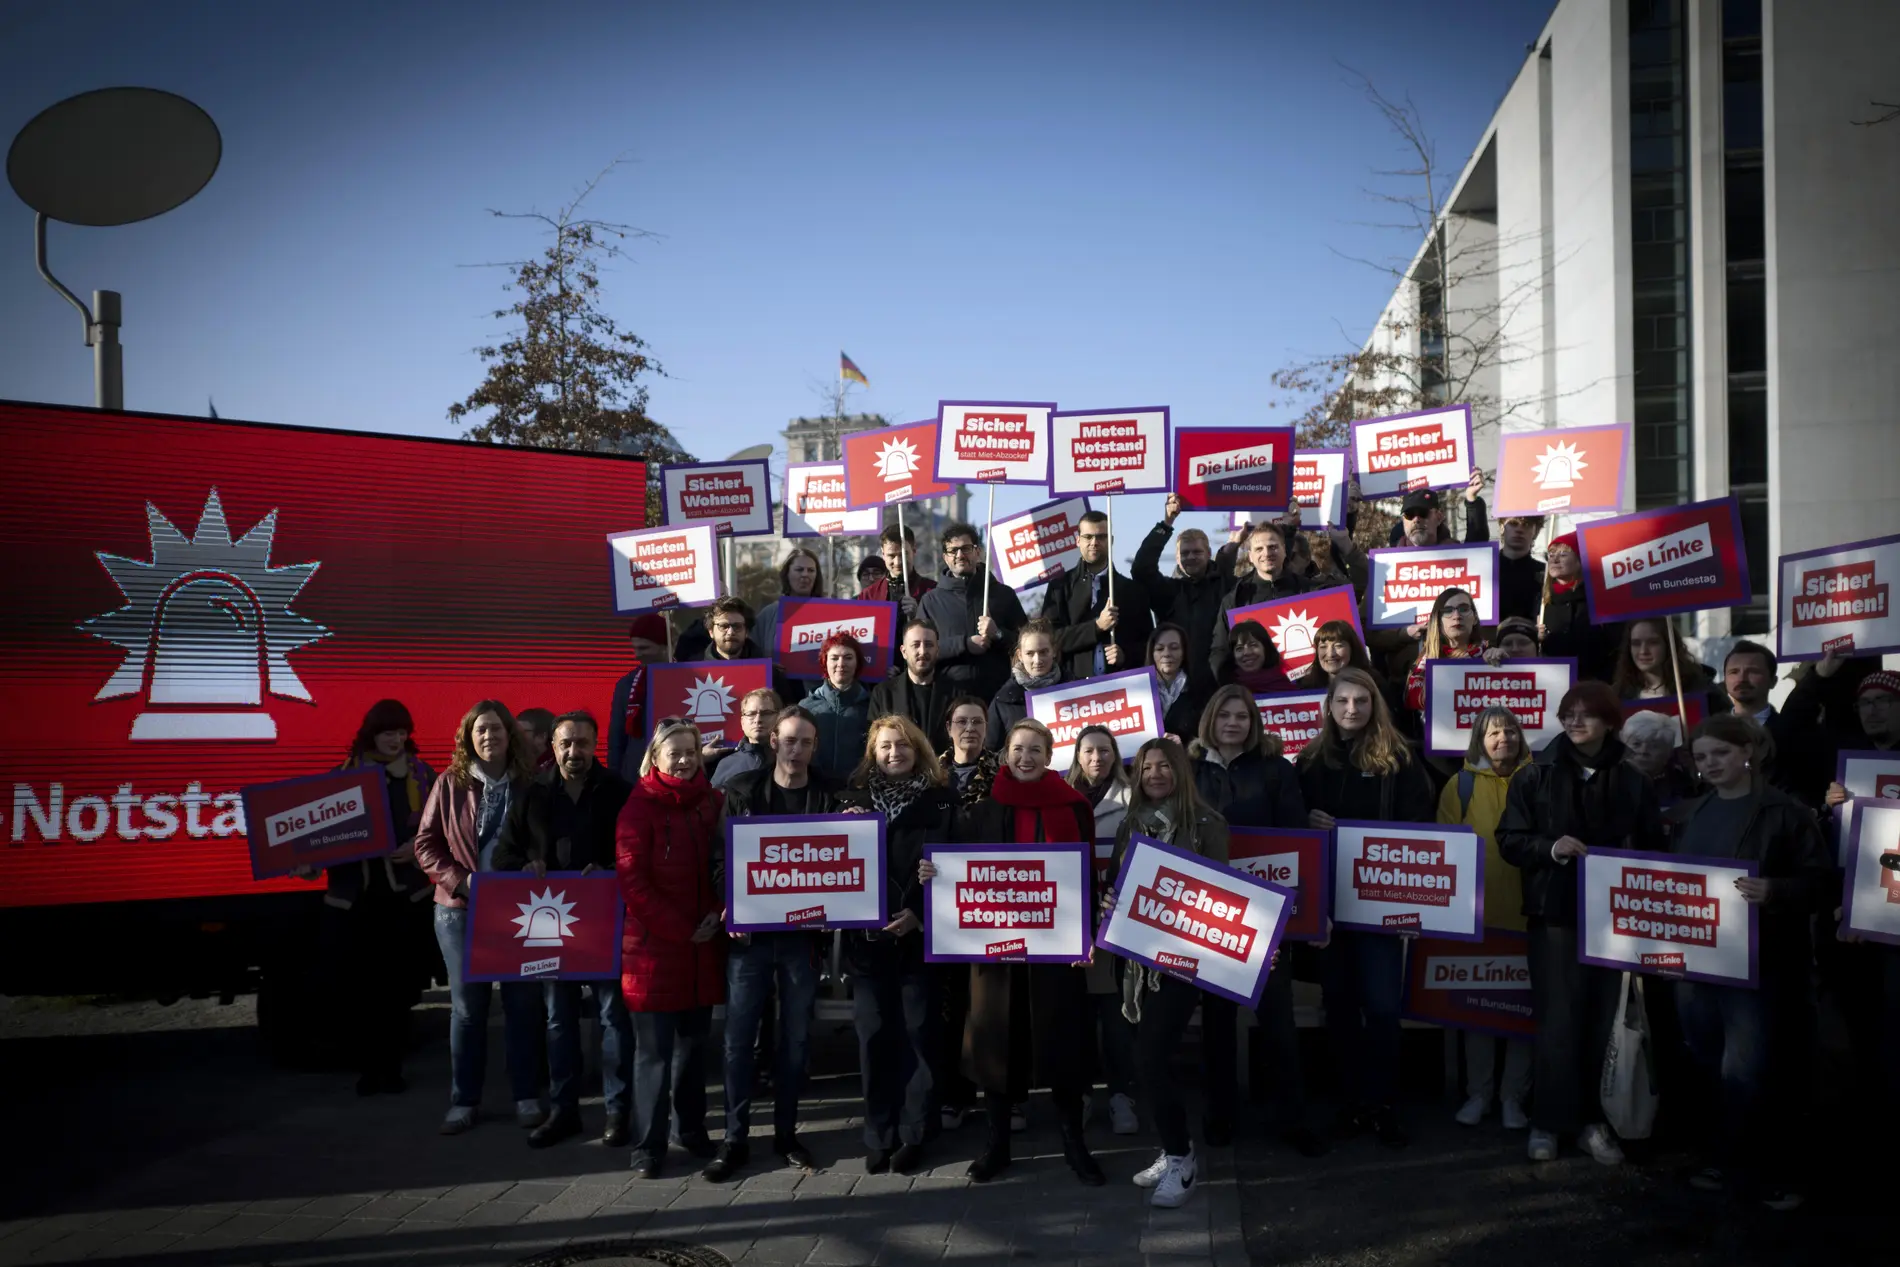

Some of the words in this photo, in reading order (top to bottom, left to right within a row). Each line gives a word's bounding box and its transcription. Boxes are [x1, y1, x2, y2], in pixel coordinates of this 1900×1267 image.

[966, 417, 1024, 433] Sicher
[1082, 426, 1134, 439] Mieten
[959, 434, 1030, 450] Wohnen
[1074, 439, 1143, 455] Notstand
[1378, 430, 1440, 451] Sicher
[977, 451, 1027, 460] Miet-Abzocke!
[1076, 454, 1142, 471] stoppen!
[1370, 444, 1453, 469] Wohnen!
[978, 471, 988, 479] Die
[1196, 461, 1221, 477] Die
[688, 477, 741, 492] Sicher
[808, 479, 846, 493] Siche
[1095, 482, 1105, 491] Die
[1232, 483, 1271, 493] Bundestag
[684, 493, 749, 508] Wohnen
[799, 495, 846, 511] Wohne
[1013, 519, 1065, 546] Sicher
[638, 541, 686, 557] Mieten
[1009, 532, 1079, 564] Wohnen!
[633, 553, 693, 573] Notstand
[1611, 554, 1644, 579] Die
[635, 569, 693, 588] stoppen!
[1398, 564, 1464, 581] Sicher
[1387, 581, 1477, 599] Wohnn!
[1663, 575, 1717, 589] Bundestag
[1806, 571, 1871, 596] Sicher
[653, 597, 662, 606] Die
[1796, 592, 1885, 621] Wohnen!
[799, 631, 825, 646] Die
[1467, 677, 1531, 690] Mieten
[1457, 694, 1542, 708] Notstand
[1058, 698, 1124, 722] Sicher
[1460, 711, 1540, 725] sten!
[1052, 712, 1139, 743] Woen!
[0, 781, 247, 842] Notsta
[275, 817, 307, 838] Die
[322, 829, 369, 844] Bundestag
[764, 843, 844, 864] Sicher
[1366, 844, 1440, 865] Sicher
[751, 866, 859, 889] Wohnen!
[970, 866, 1041, 882] Mieten
[1357, 866, 1450, 889] Wohnen
[1625, 874, 1701, 896] Mieten
[959, 887, 1052, 904] Notstand
[1154, 875, 1240, 923] Sicher
[1360, 887, 1380, 898] statt
[1381, 889, 1447, 904] Miet-Abzocke!
[1613, 893, 1715, 920] Notstand
[789, 912, 800, 922] Die
[962, 907, 1049, 927] stoppen!
[1137, 893, 1248, 955] Wohnen!
[1385, 918, 1397, 926] Die
[1616, 914, 1711, 940] stoppen!
[988, 946, 1001, 955] Die
[1158, 954, 1172, 964] Die
[524, 963, 536, 973] Die
[1643, 956, 1657, 965] Die
[1434, 965, 1467, 982] Die
[1480, 998, 1533, 1017] Bundestag
